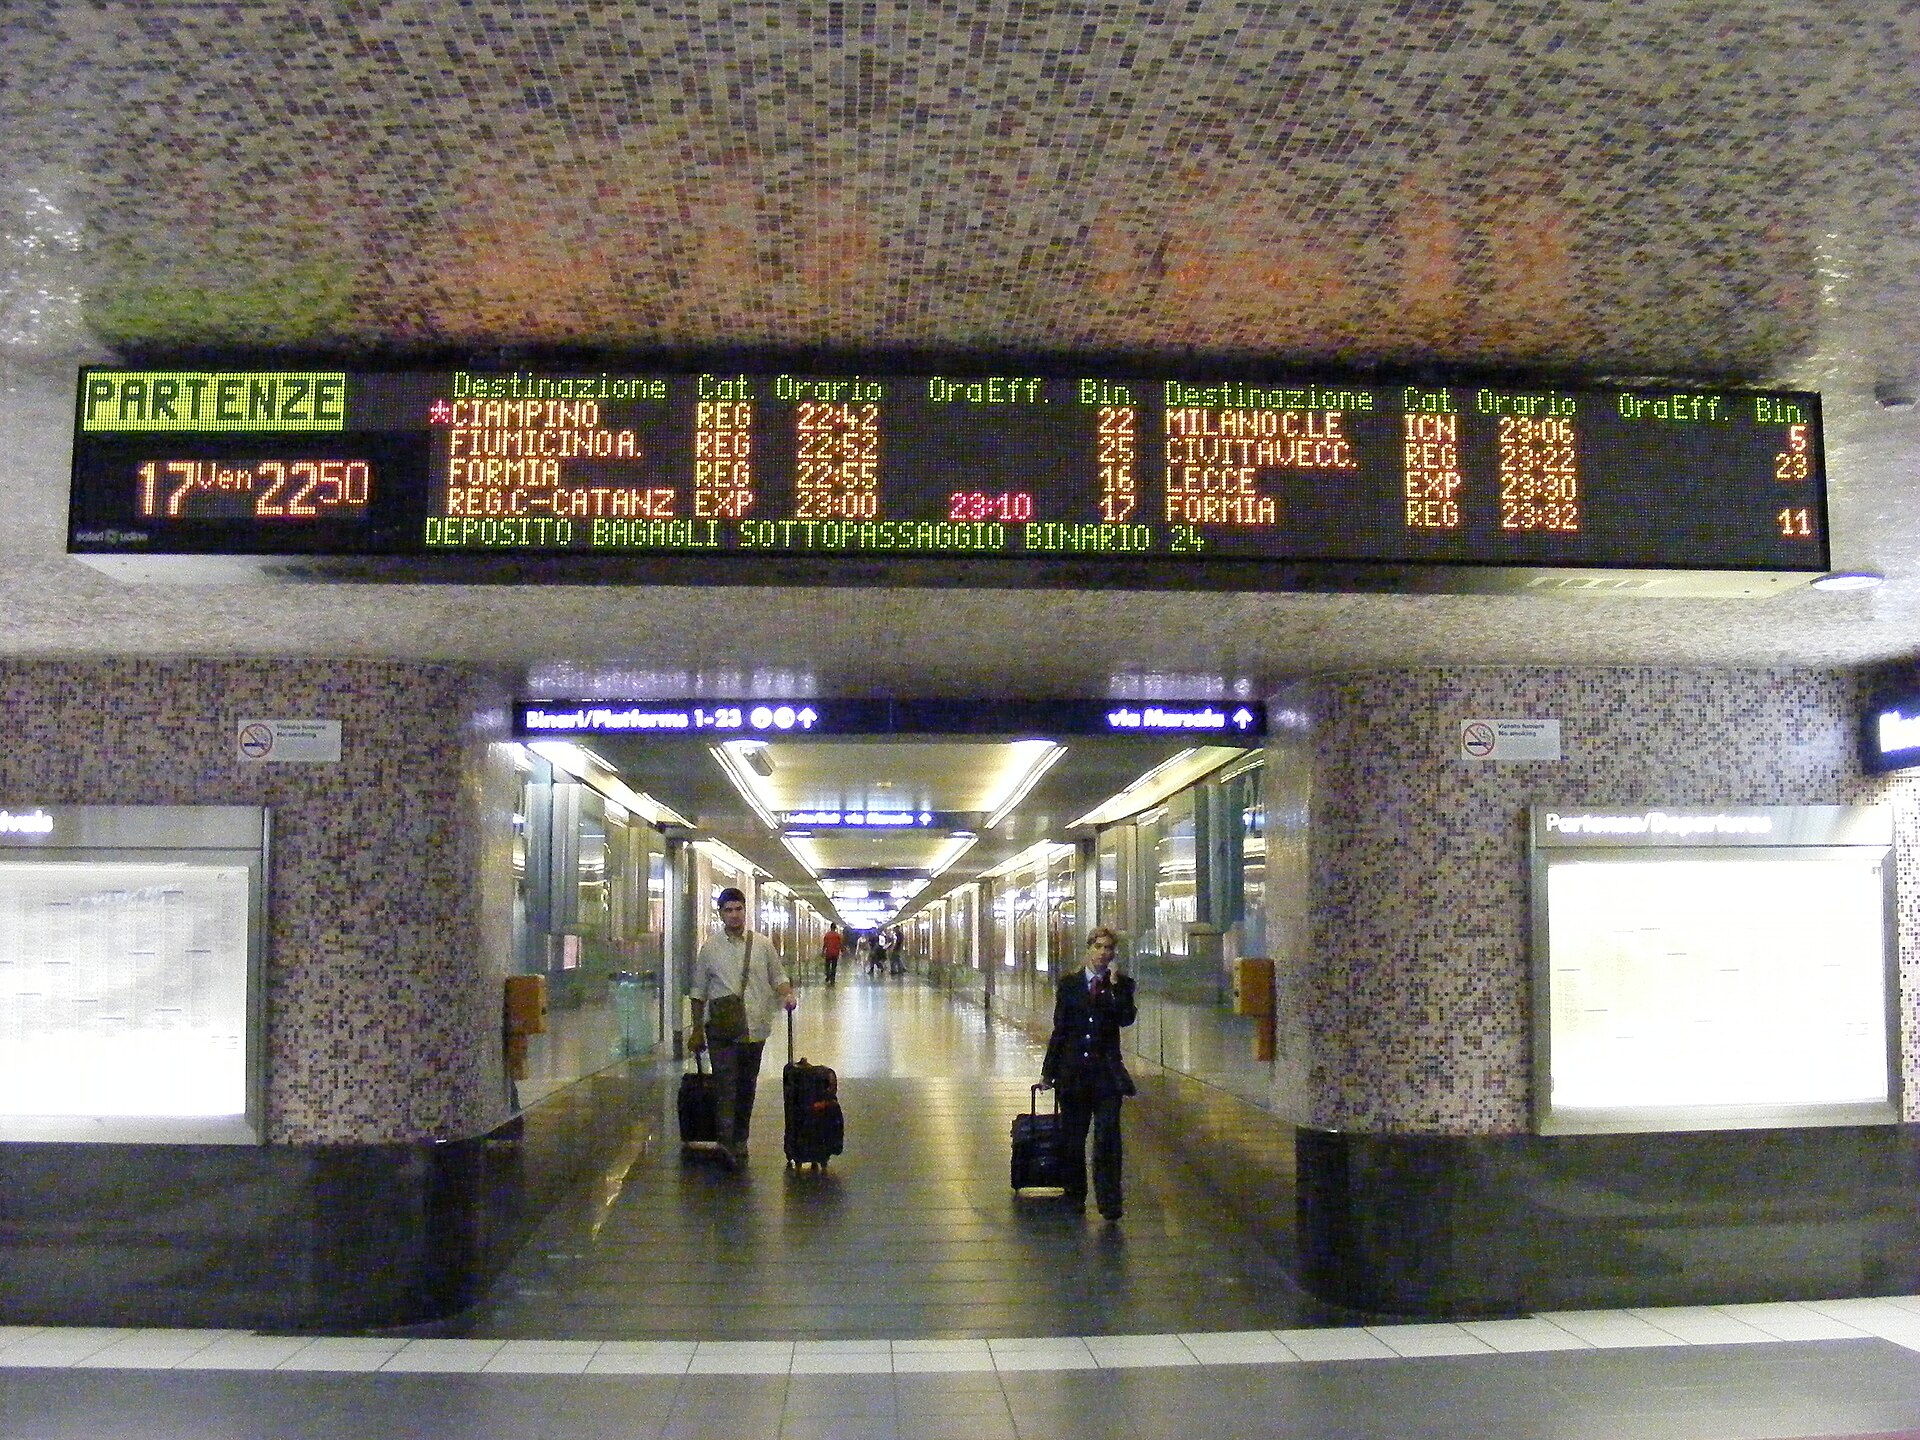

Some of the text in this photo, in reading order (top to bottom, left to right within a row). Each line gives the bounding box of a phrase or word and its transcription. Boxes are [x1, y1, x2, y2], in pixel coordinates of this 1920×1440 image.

[87, 379, 344, 421] PARTENZE
[454, 371, 1138, 405] Destinazione Cat. Orario OraEff. Bin.
[1165, 380, 1808, 424] Destinazione Cat. Orario OraEff. Bin.
[451, 400, 1134, 434] CIAMPINO REG 22:42 22
[1404, 414, 1457, 443] ICN
[1499, 416, 1575, 444] 23:06
[1789, 425, 1807, 452] 5
[696, 431, 750, 458] REG
[797, 432, 878, 460] 22:52
[1099, 435, 1135, 463] 25
[1166, 437, 1808, 479] CIVITAVECC. REG 23:22 23
[138, 461, 195, 515] 17
[197, 461, 252, 490] Ven
[449, 457, 1135, 493] FORMIA REG 22:55 16
[1166, 465, 1577, 501] LECCE EXP 23:30
[447, 488, 1135, 522] REG.C-CATANZ EXP 23:00 23:10 17
[1166, 495, 1812, 535] FORMIA REG 23:32 11
[424, 516, 1205, 552] DEPOSITO BAGAGLI SOTTOPASSAGGIO BINARIO 24
[693, 708, 743, 728] 1-23
